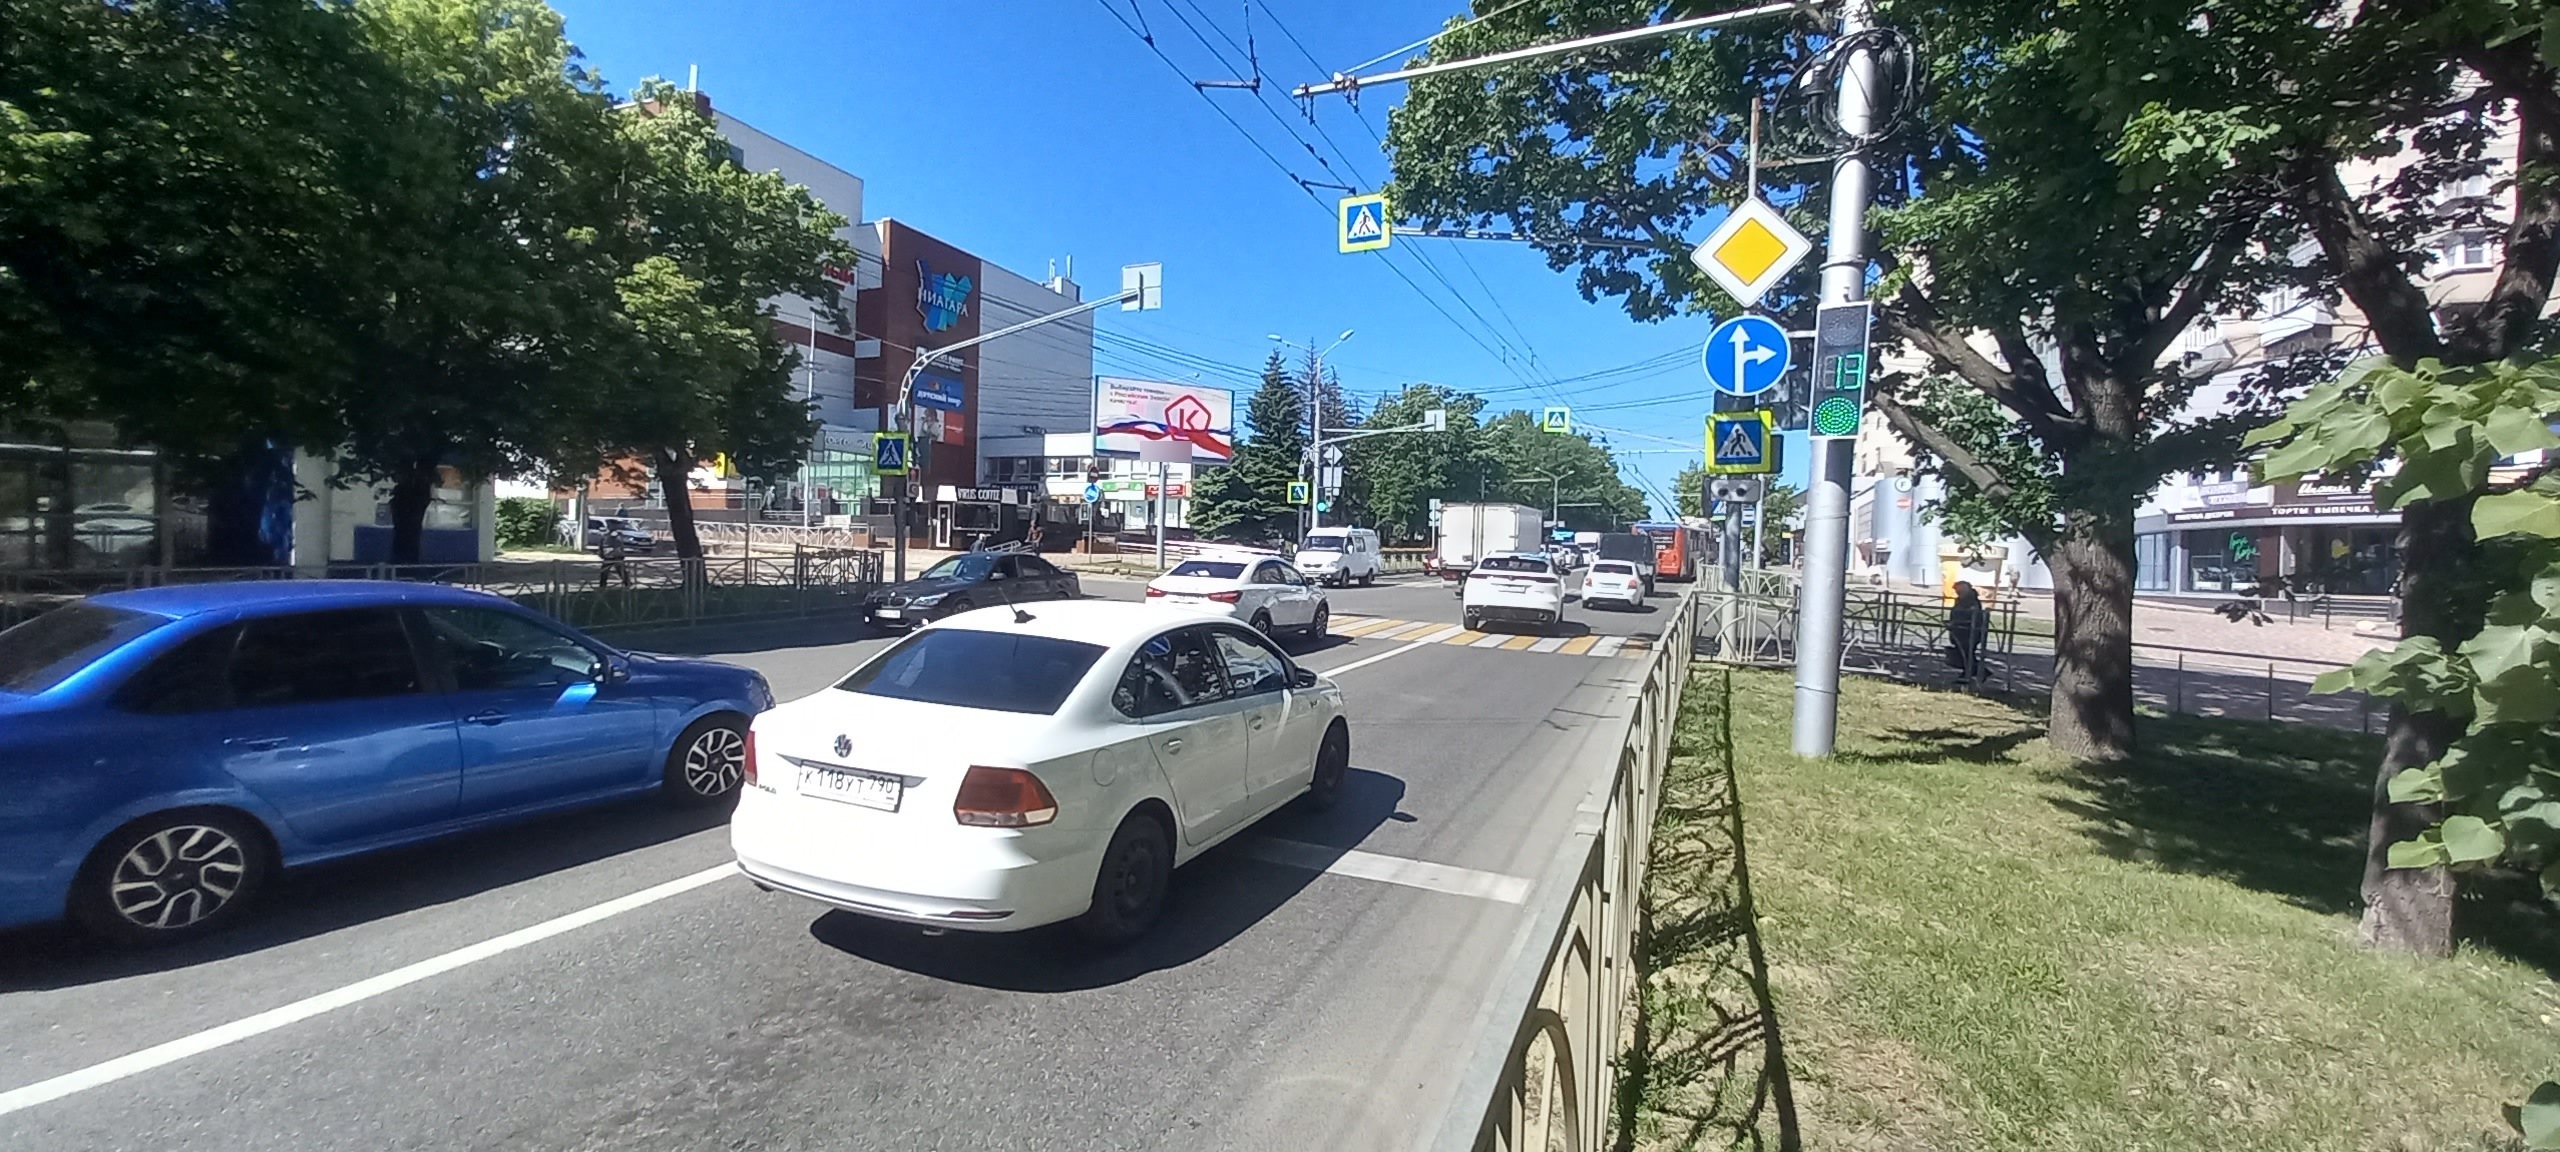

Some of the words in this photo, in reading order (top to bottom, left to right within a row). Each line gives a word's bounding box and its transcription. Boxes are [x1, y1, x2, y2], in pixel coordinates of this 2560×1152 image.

[922, 289, 969, 317] НИАГАРА
[1836, 354, 1863, 389] 13
[978, 489, 1001, 501] COFFEE
[2271, 507, 2309, 515] ТОРТЫ
[2314, 505, 2370, 514] ВЫПЕЧКА
